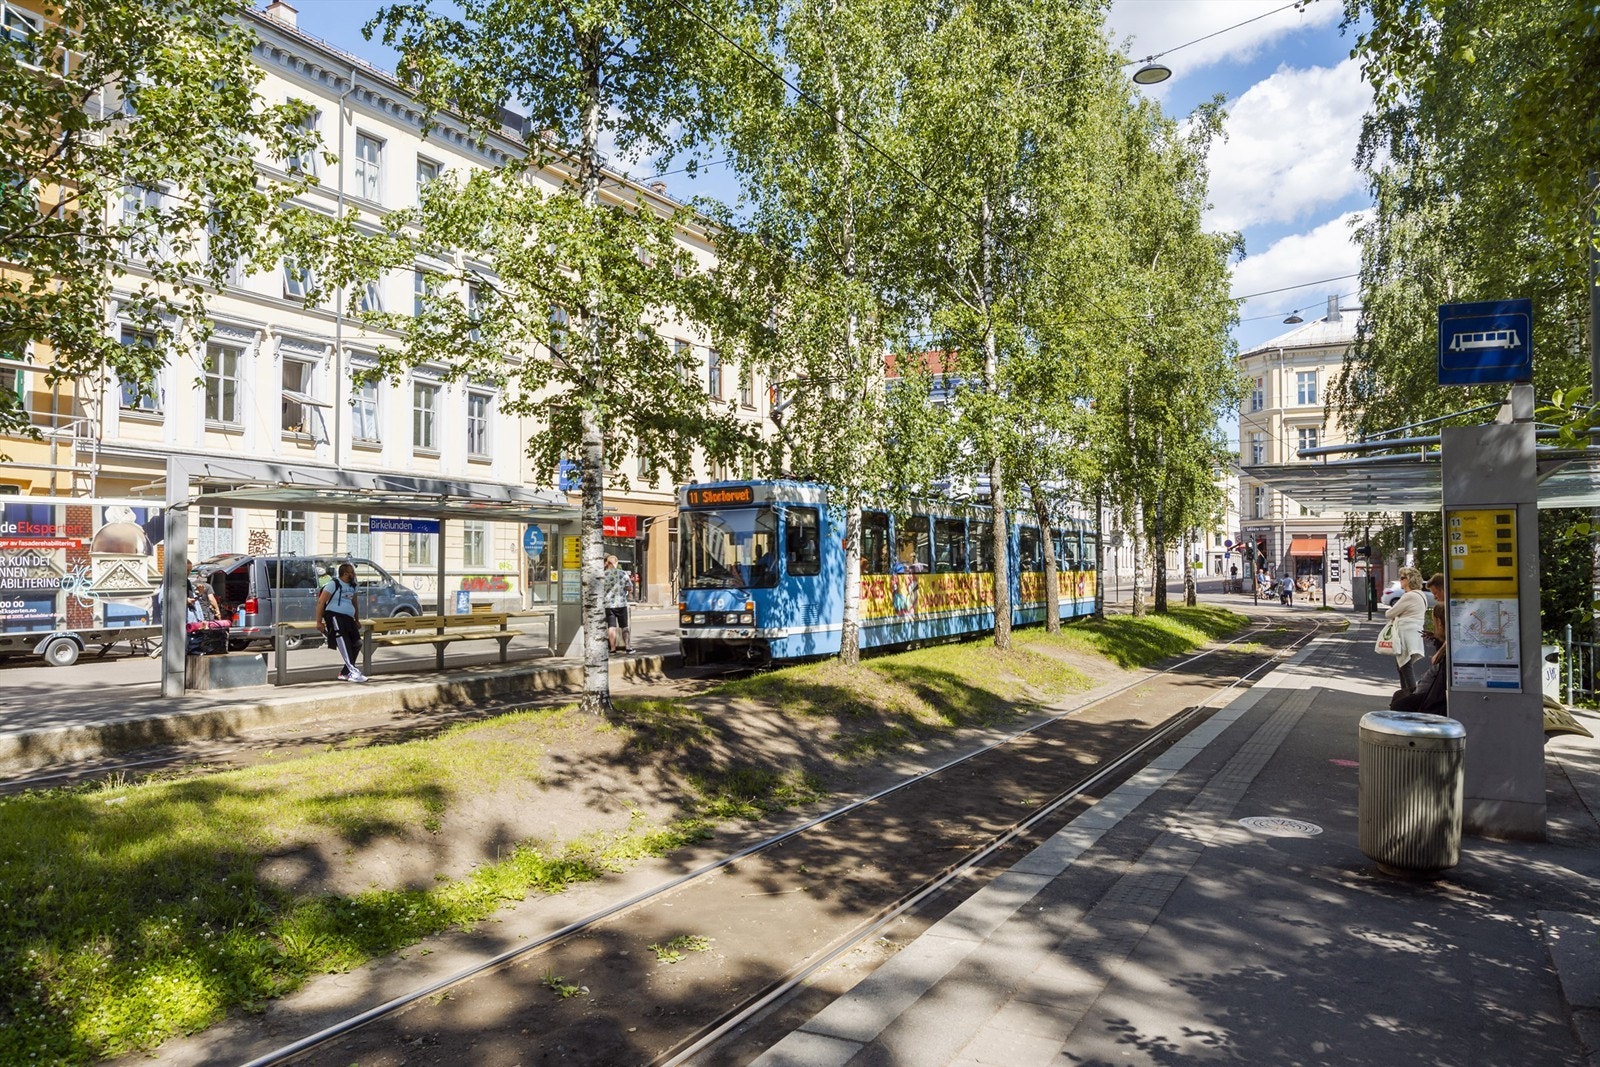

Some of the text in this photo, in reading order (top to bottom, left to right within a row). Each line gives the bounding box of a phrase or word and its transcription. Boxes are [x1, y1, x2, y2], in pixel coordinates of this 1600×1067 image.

[690, 489, 750, 503] 11 Stortorvet
[370, 520, 413, 530] Birkelunden
[1451, 518, 1460, 526] 11
[1451, 532, 1461, 540] 12
[1454, 546, 1465, 554] 18
[9, 557, 30, 566] KUN
[33, 557, 51, 566] DET
[0, 568, 27, 577] NNEN
[0, 578, 60, 588] ABILITERING
[13, 600, 25, 608] 00
